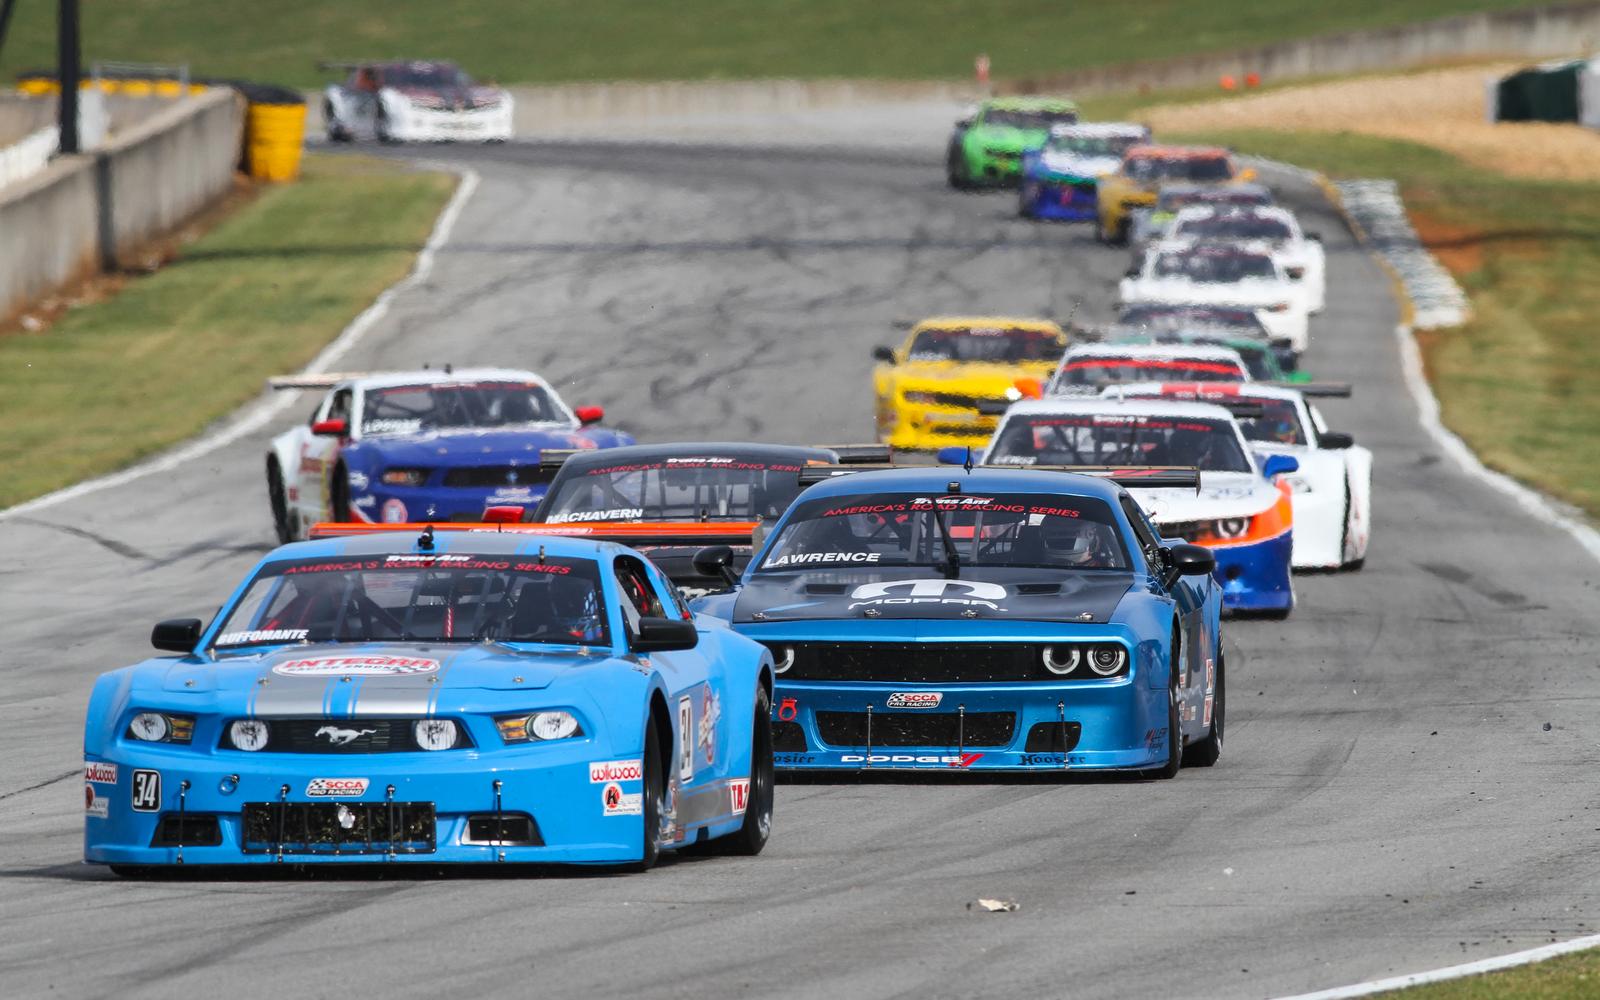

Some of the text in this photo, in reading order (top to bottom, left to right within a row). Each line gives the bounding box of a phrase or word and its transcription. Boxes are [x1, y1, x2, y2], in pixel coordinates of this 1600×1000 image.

[588, 463, 661, 475] AMERICA'S
[546, 508, 643, 524] MACHAVERN
[824, 503, 1080, 517] AMERICA'S ROAD RACING SERIES
[762, 552, 881, 568] LAWRENCE
[283, 561, 378, 574] AMERICA'S
[439, 560, 508, 570] RACING
[514, 563, 571, 575] SERIES
[848, 598, 999, 611] MOPAR
[286, 656, 433, 668] INTEGRA
[904, 694, 938, 702] SCCA
[773, 753, 815, 763] osier
[841, 755, 961, 764] DODGE
[1017, 754, 1087, 766] Hooser
[133, 773, 157, 807] 34
[326, 781, 363, 789] SCCA
